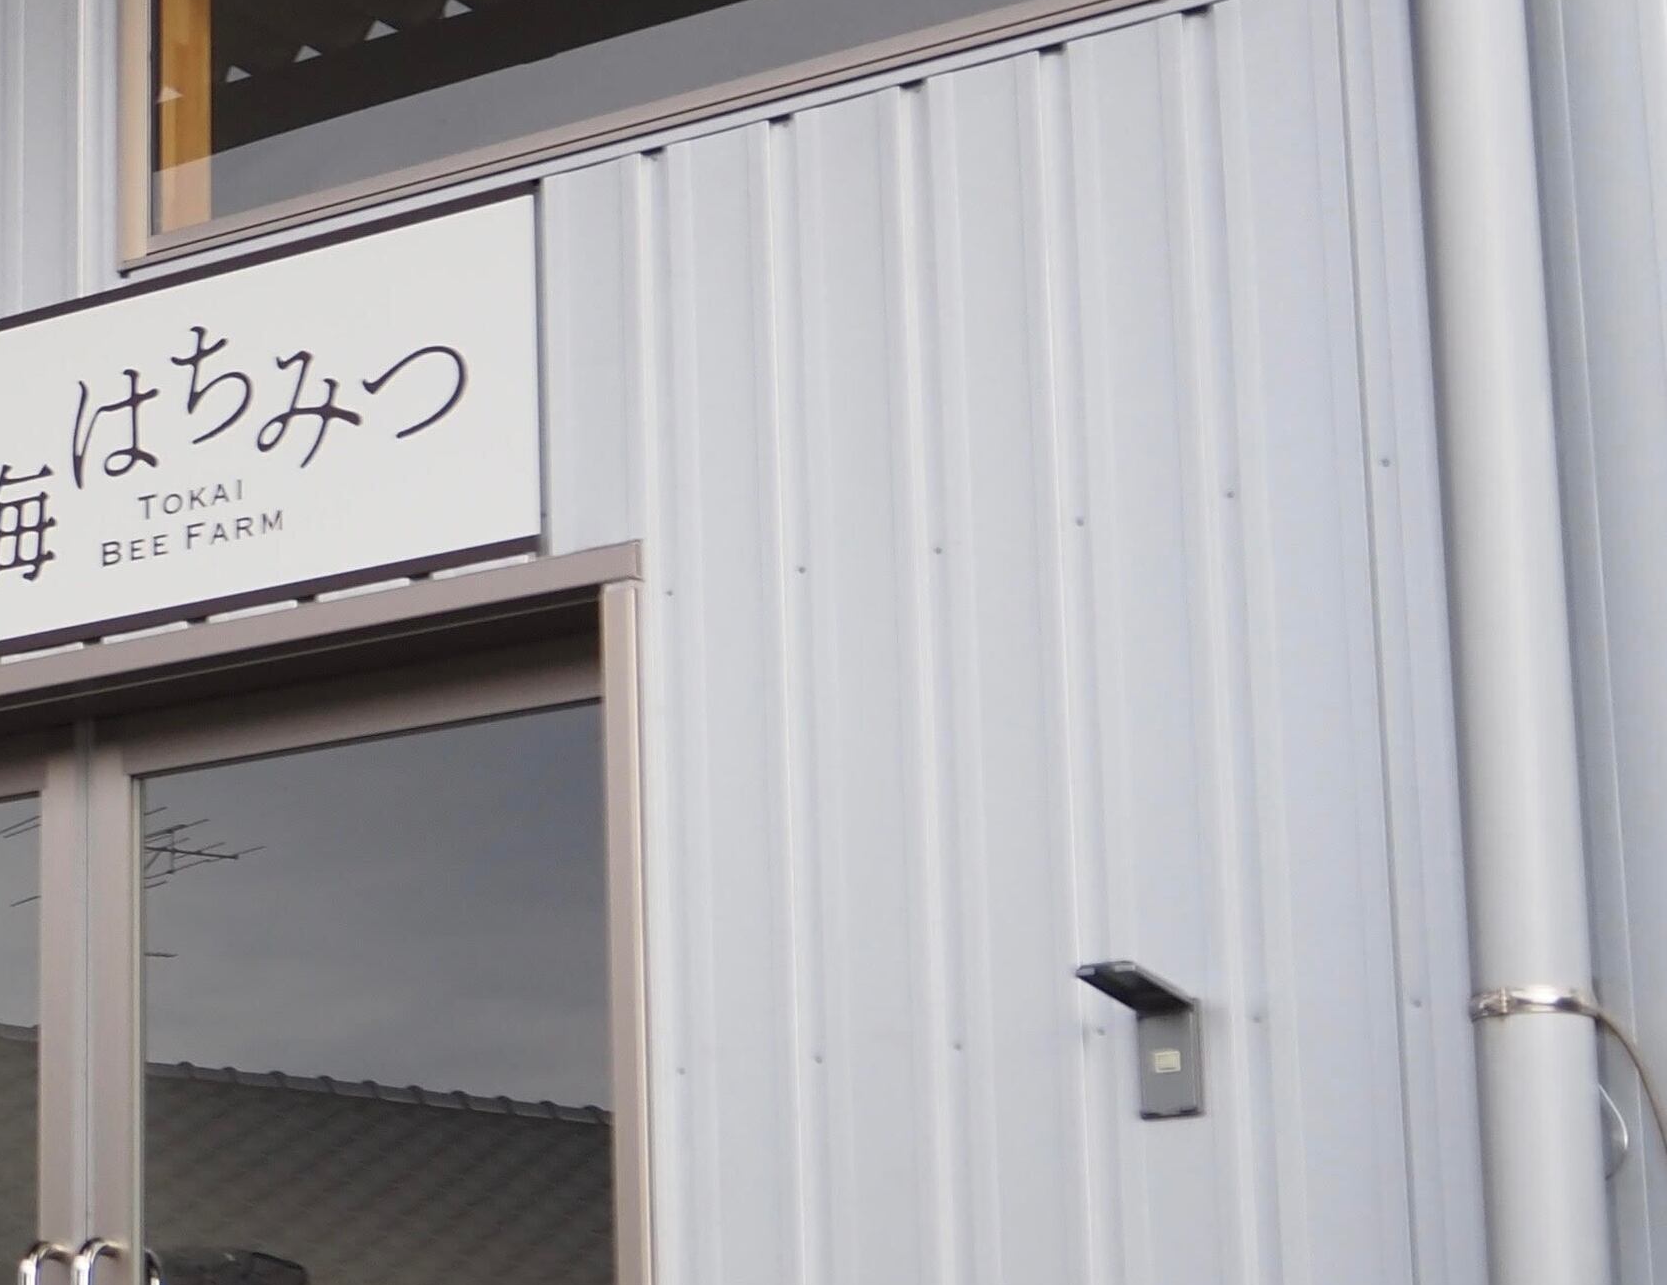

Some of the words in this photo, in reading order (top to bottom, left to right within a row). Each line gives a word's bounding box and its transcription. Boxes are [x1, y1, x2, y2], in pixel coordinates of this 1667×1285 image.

[137, 479, 245, 520] TOKAI
[100, 534, 170, 568] BEE
[185, 509, 285, 552] FARM
